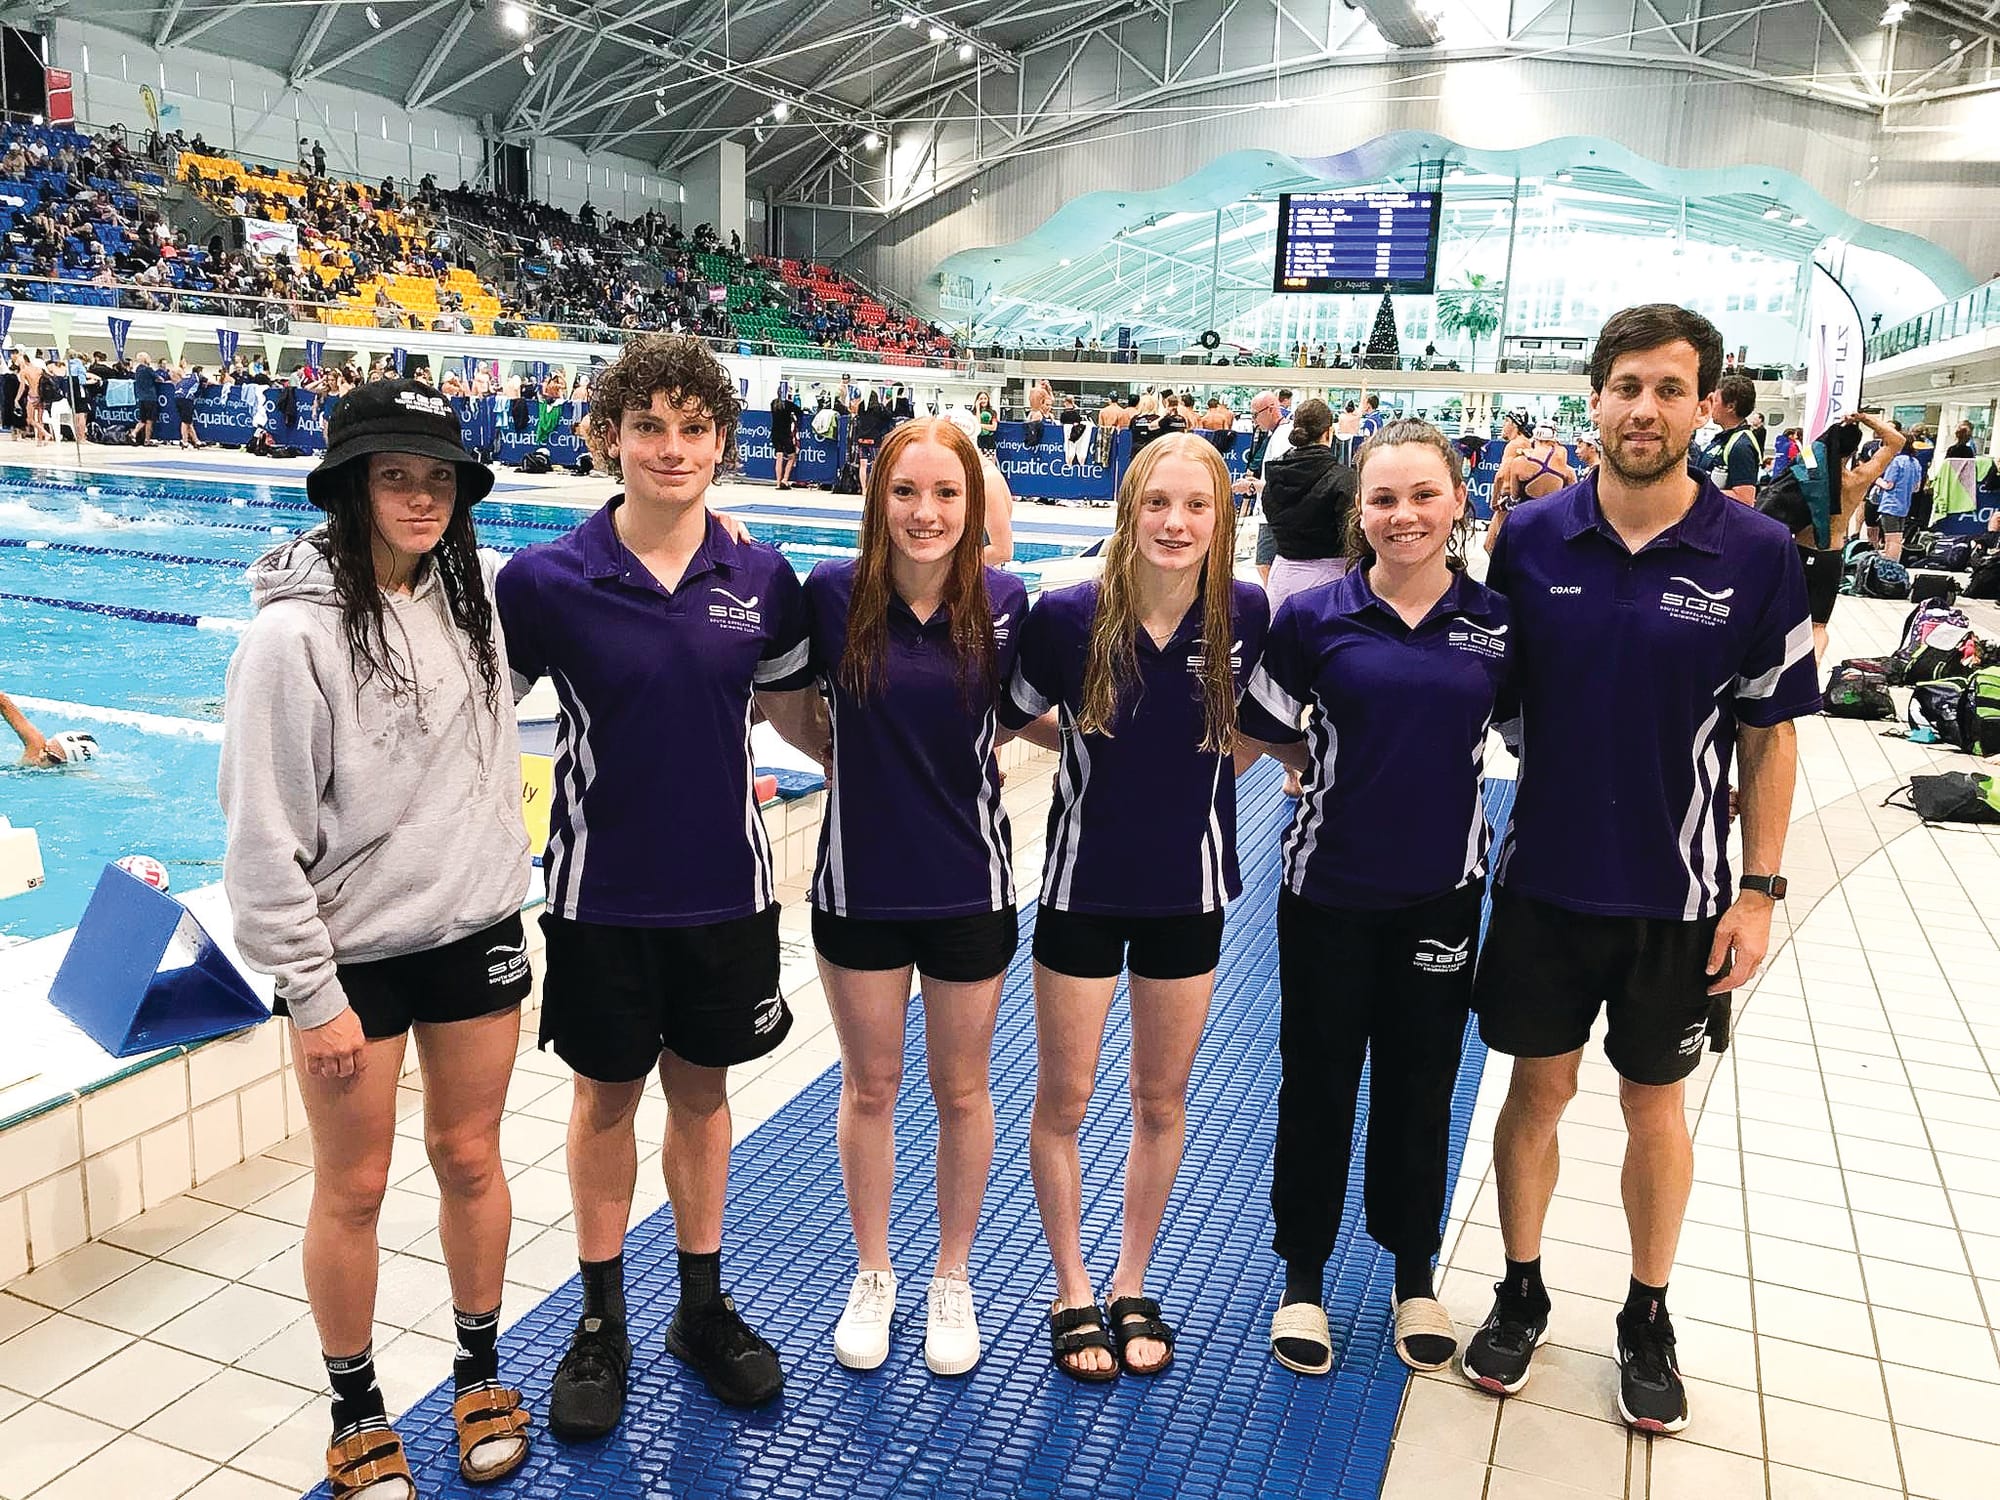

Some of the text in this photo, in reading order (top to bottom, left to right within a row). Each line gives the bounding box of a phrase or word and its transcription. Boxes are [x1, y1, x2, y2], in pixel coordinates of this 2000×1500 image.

[95, 406, 133, 424] Aquatic
[192, 409, 236, 428] Aquatic
[739, 442, 777, 462] quatic
[1001, 458, 1103, 479] quatic Centre
[1550, 586, 1582, 595] COACH
[1661, 592, 1731, 617] SGB
[709, 605, 760, 624] SGB
[1449, 632, 1505, 652] SGB
[1186, 655, 1242, 668] SB
[1415, 951, 1468, 963] SGB
